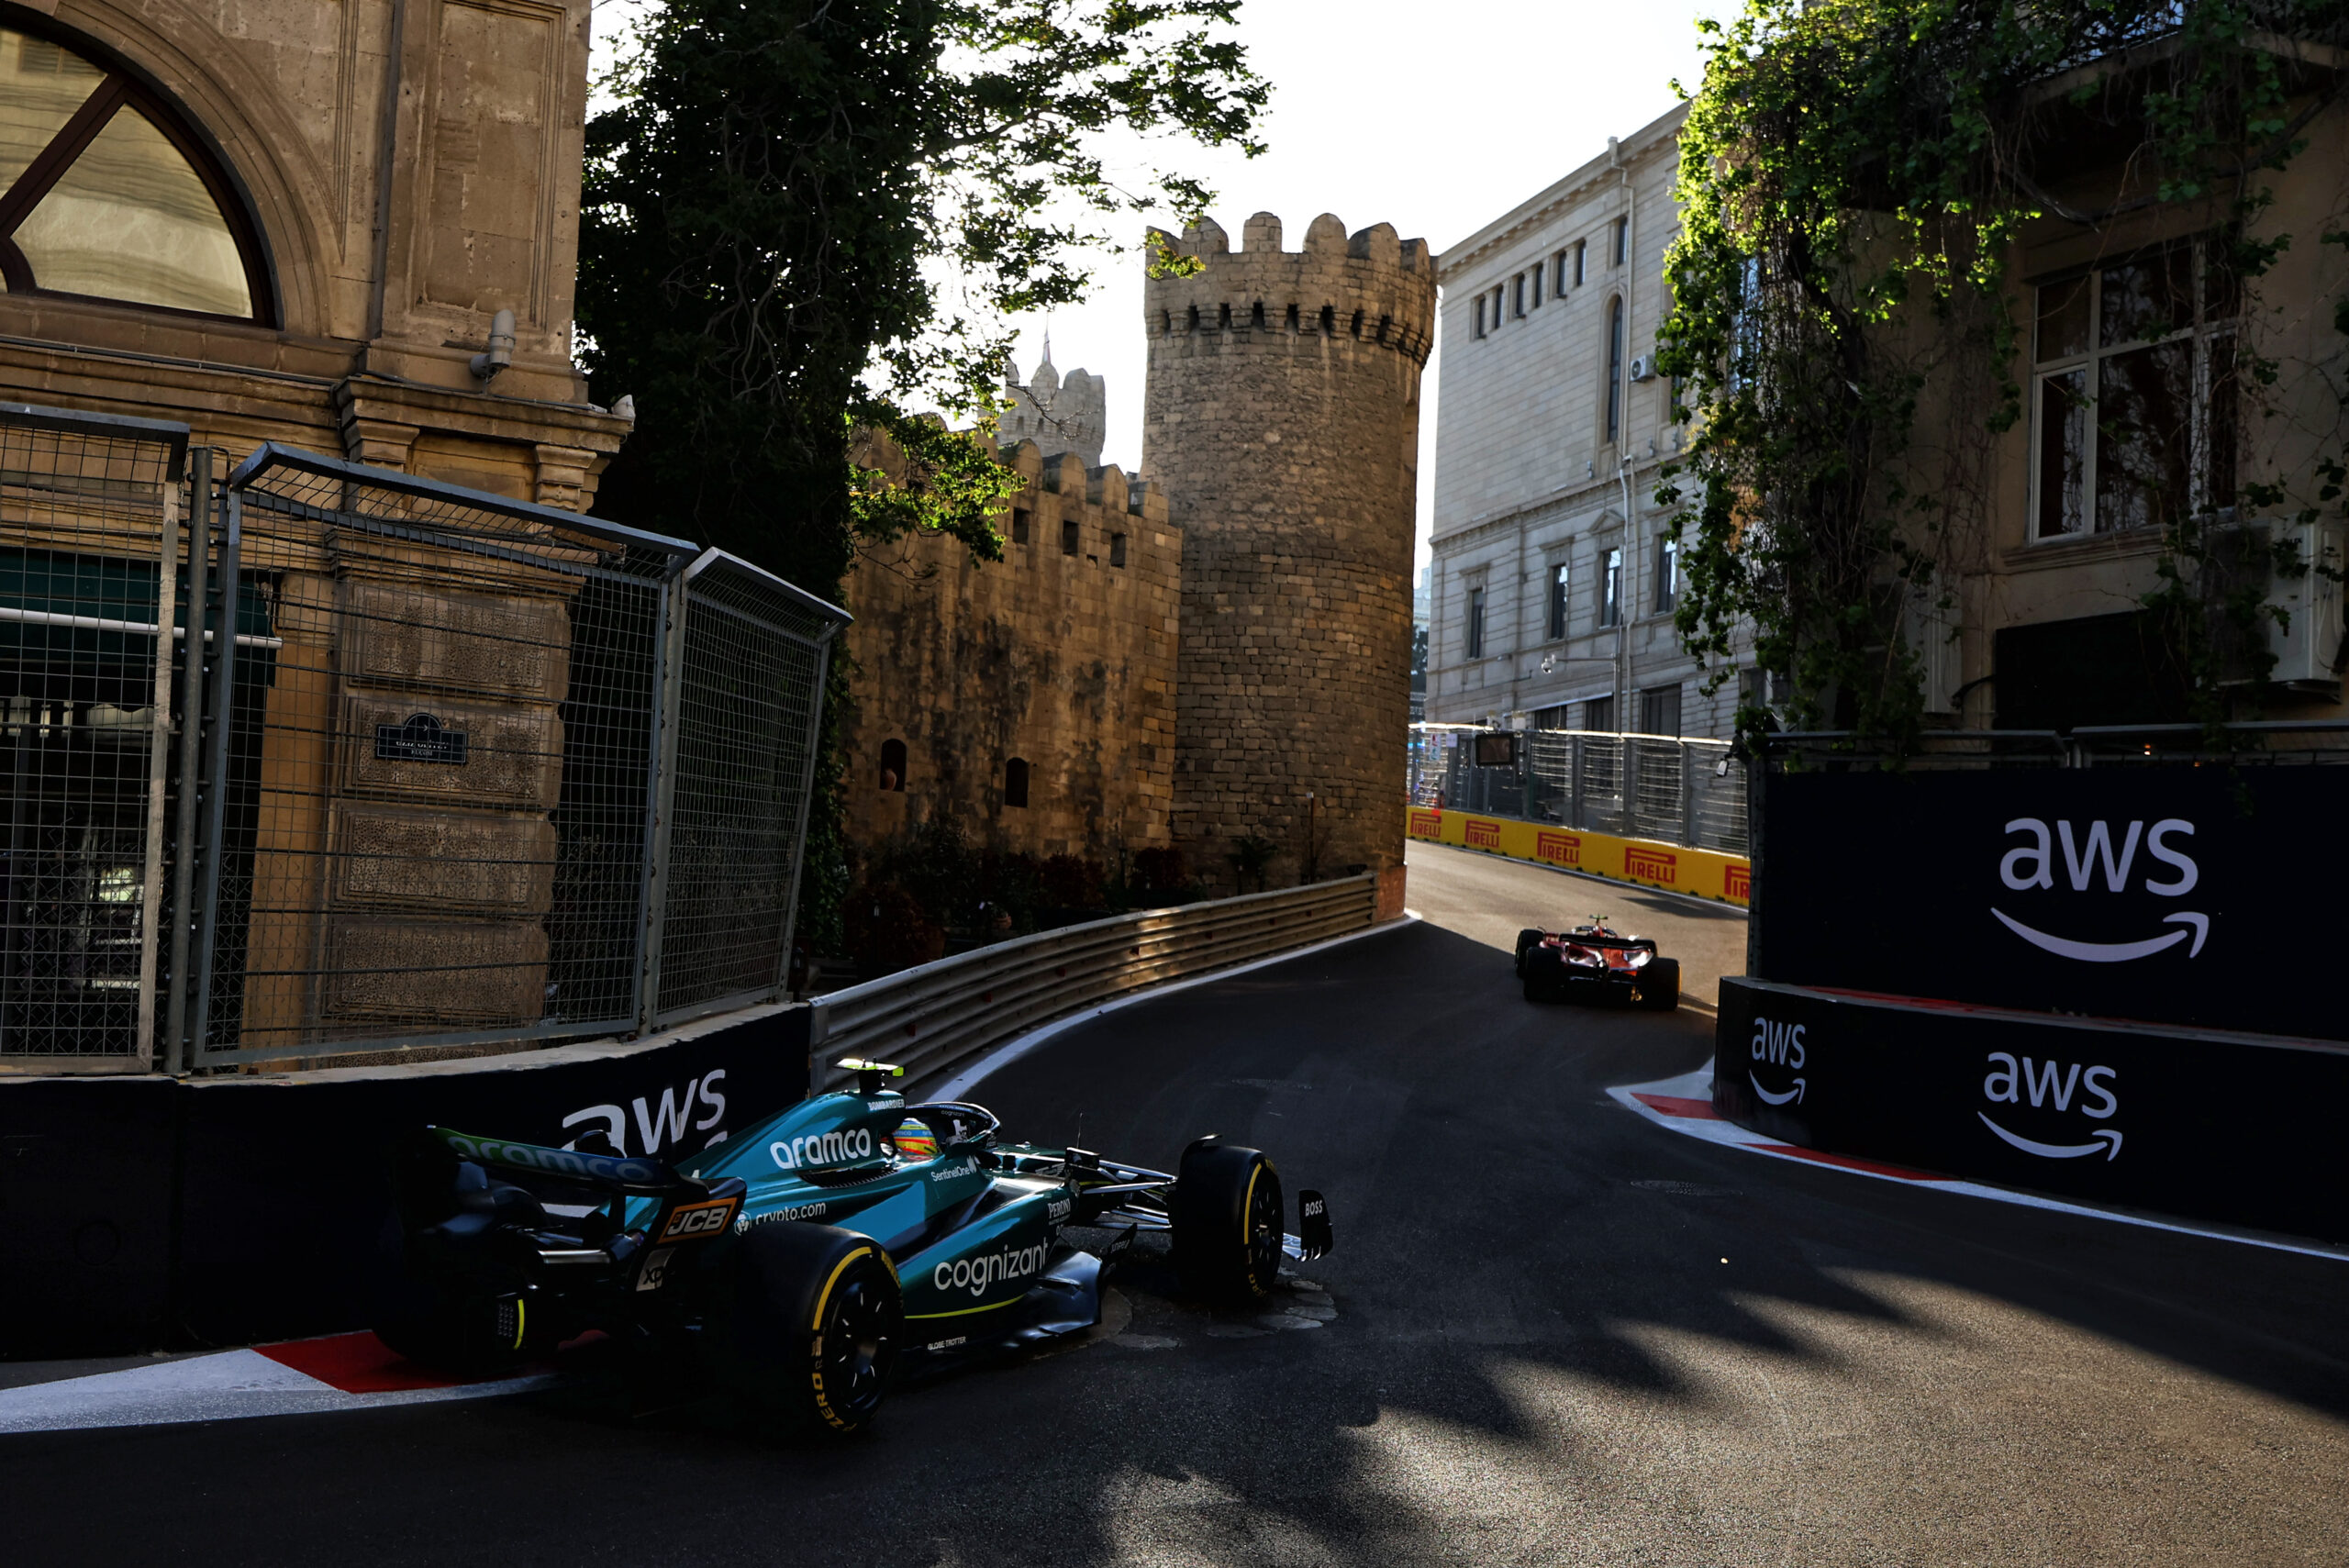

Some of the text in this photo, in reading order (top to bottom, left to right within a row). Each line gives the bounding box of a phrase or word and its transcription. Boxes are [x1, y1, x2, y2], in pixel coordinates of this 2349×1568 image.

[1410, 812, 1442, 838] PIRELLI
[1464, 820, 1500, 848] PIRELLI
[1537, 831, 1580, 863] PIRELLI
[1999, 817, 2199, 896] aws
[1625, 847, 1676, 884] PIRELLI
[1752, 1017, 1806, 1070] aws
[1984, 1051, 2119, 1119] aws
[867, 1098, 905, 1112] BOMBARDIER
[447, 1136, 655, 1183] aramco
[769, 1128, 872, 1170] aramco
[930, 1165, 971, 1182] SentinelOne
[666, 1207, 729, 1236] JCB
[1047, 1197, 1071, 1219] PERONI
[1305, 1199, 1323, 1218] BOSS
[934, 1236, 1049, 1297] cognizant
